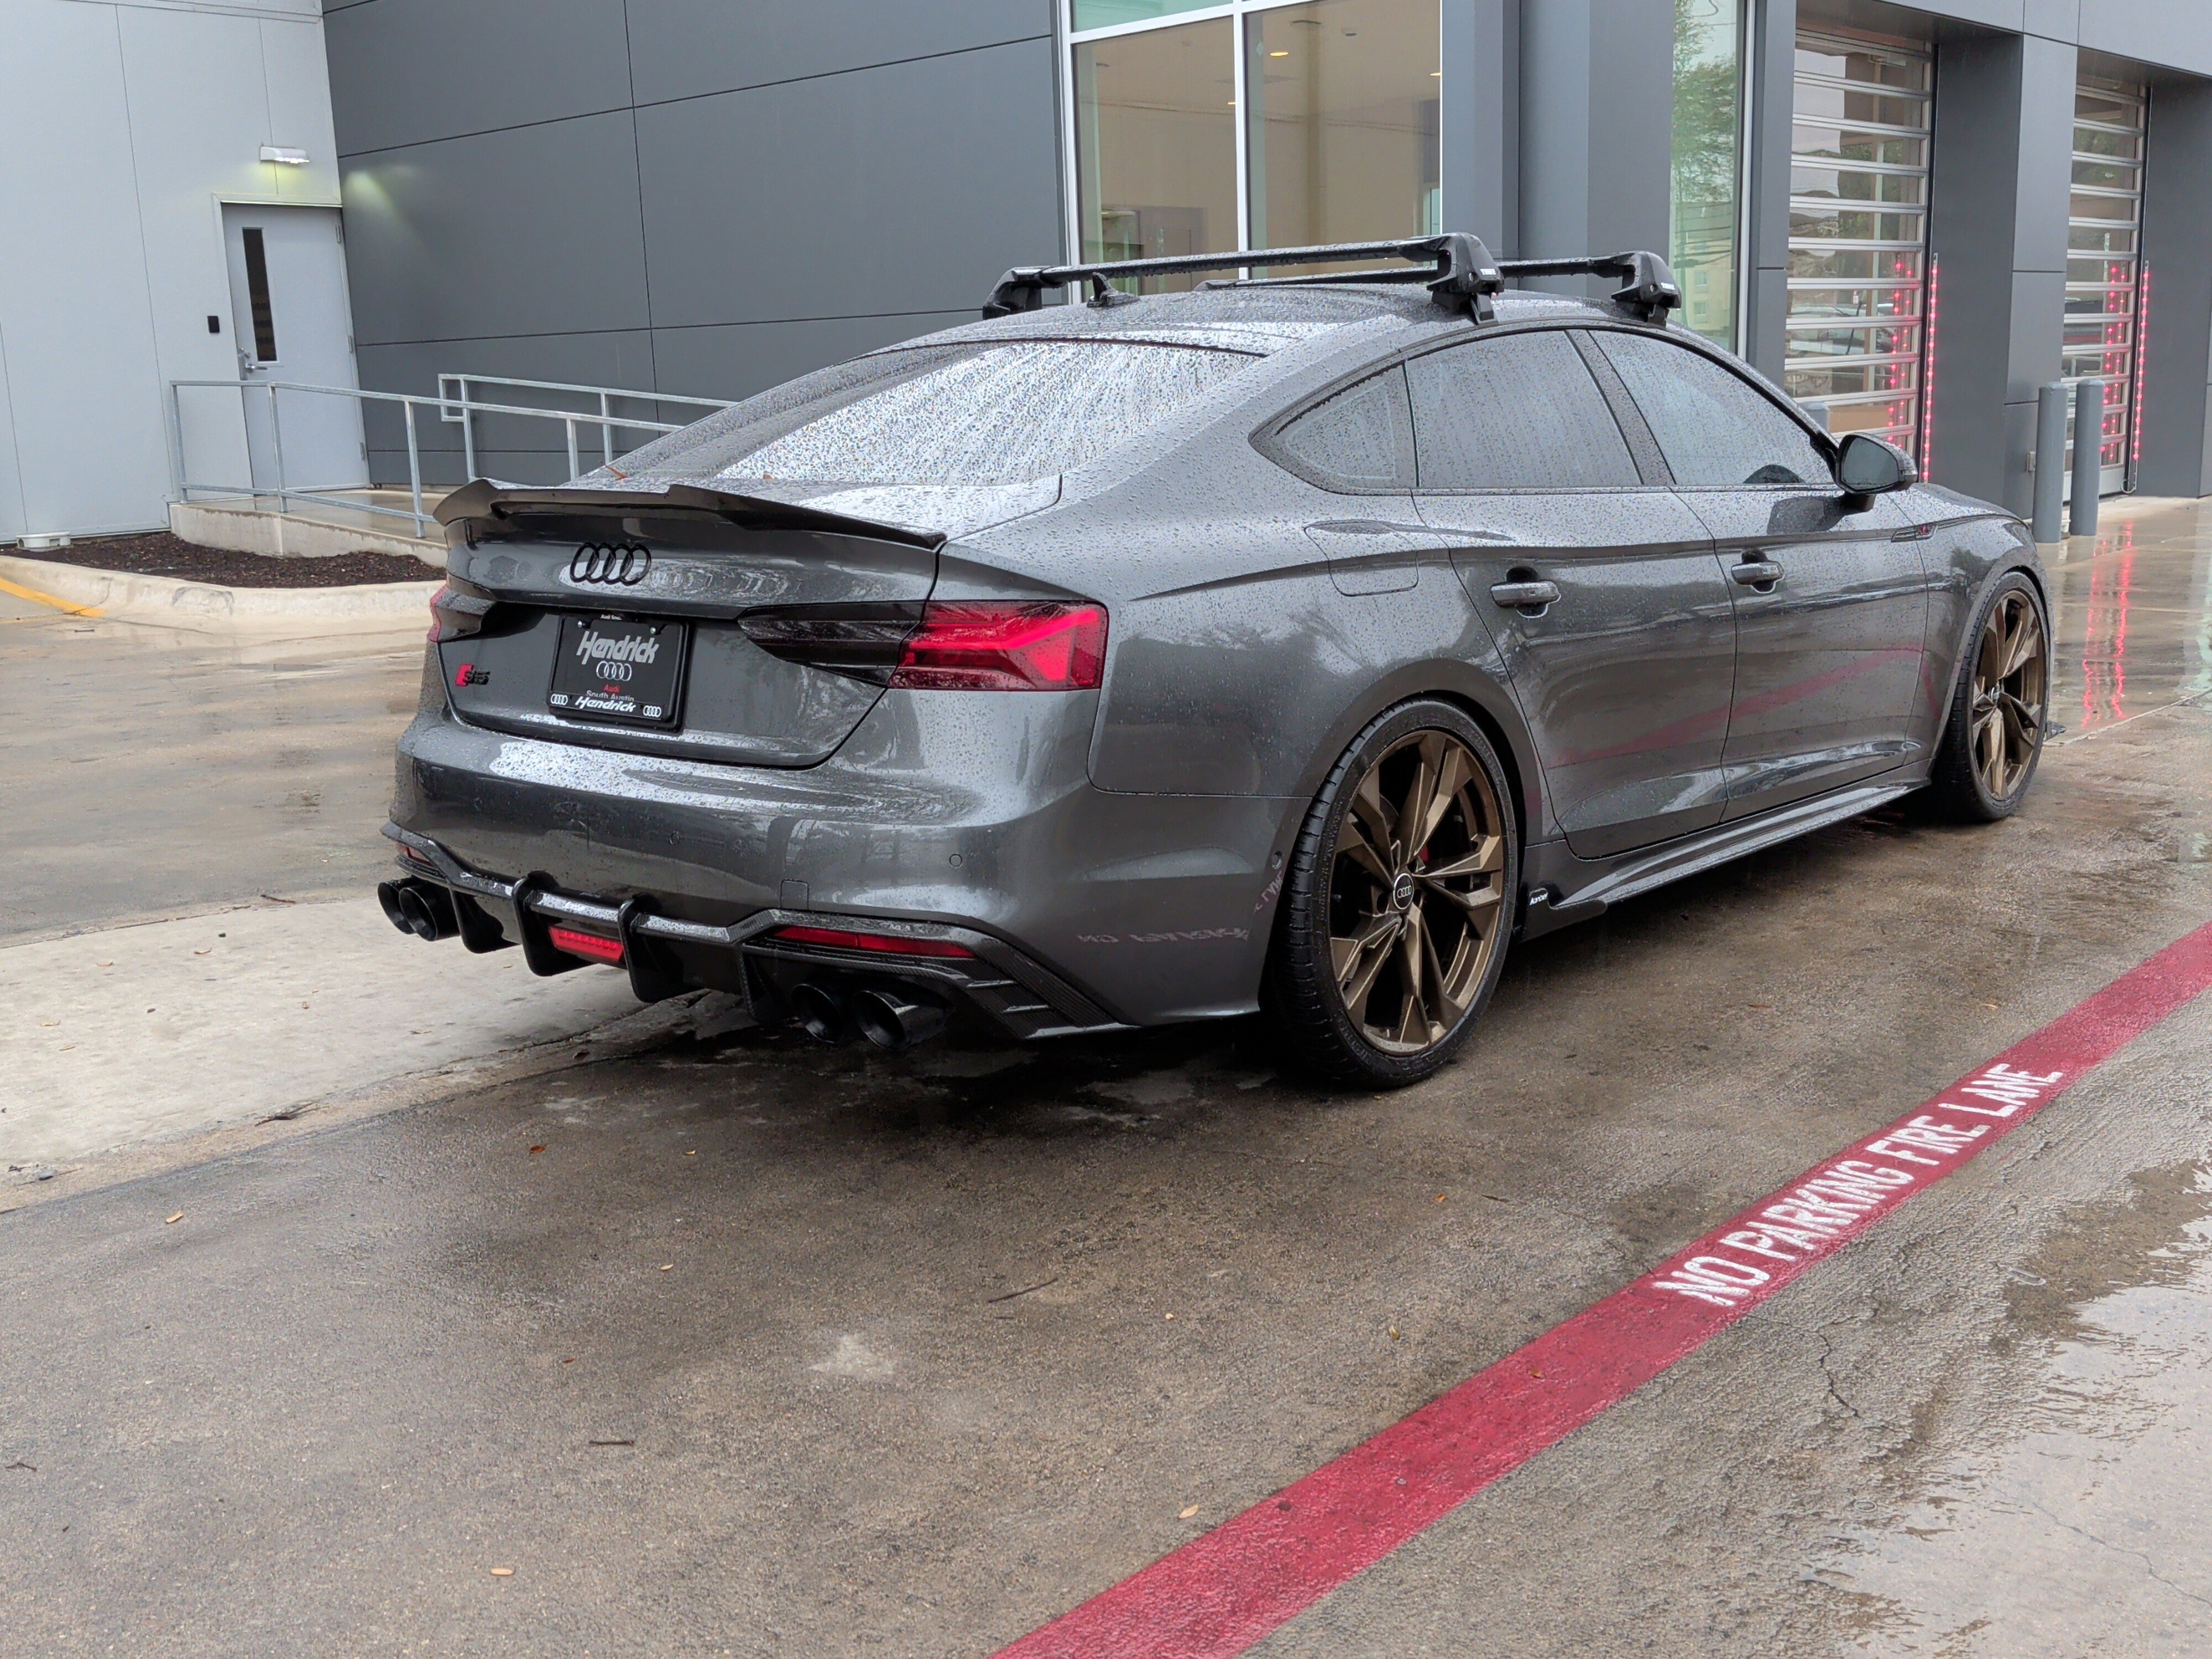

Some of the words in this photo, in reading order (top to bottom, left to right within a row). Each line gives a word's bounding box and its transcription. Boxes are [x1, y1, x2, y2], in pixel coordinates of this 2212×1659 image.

[576, 630, 660, 665] Hendrick
[603, 684, 620, 693] Audi
[575, 696, 637, 712] Hendrick
[1652, 1256, 1771, 1307] NO
[1718, 1160, 1915, 1261] PARKING
[1865, 1114, 1992, 1166] FIRE
[1937, 1062, 2064, 1118] LANE
